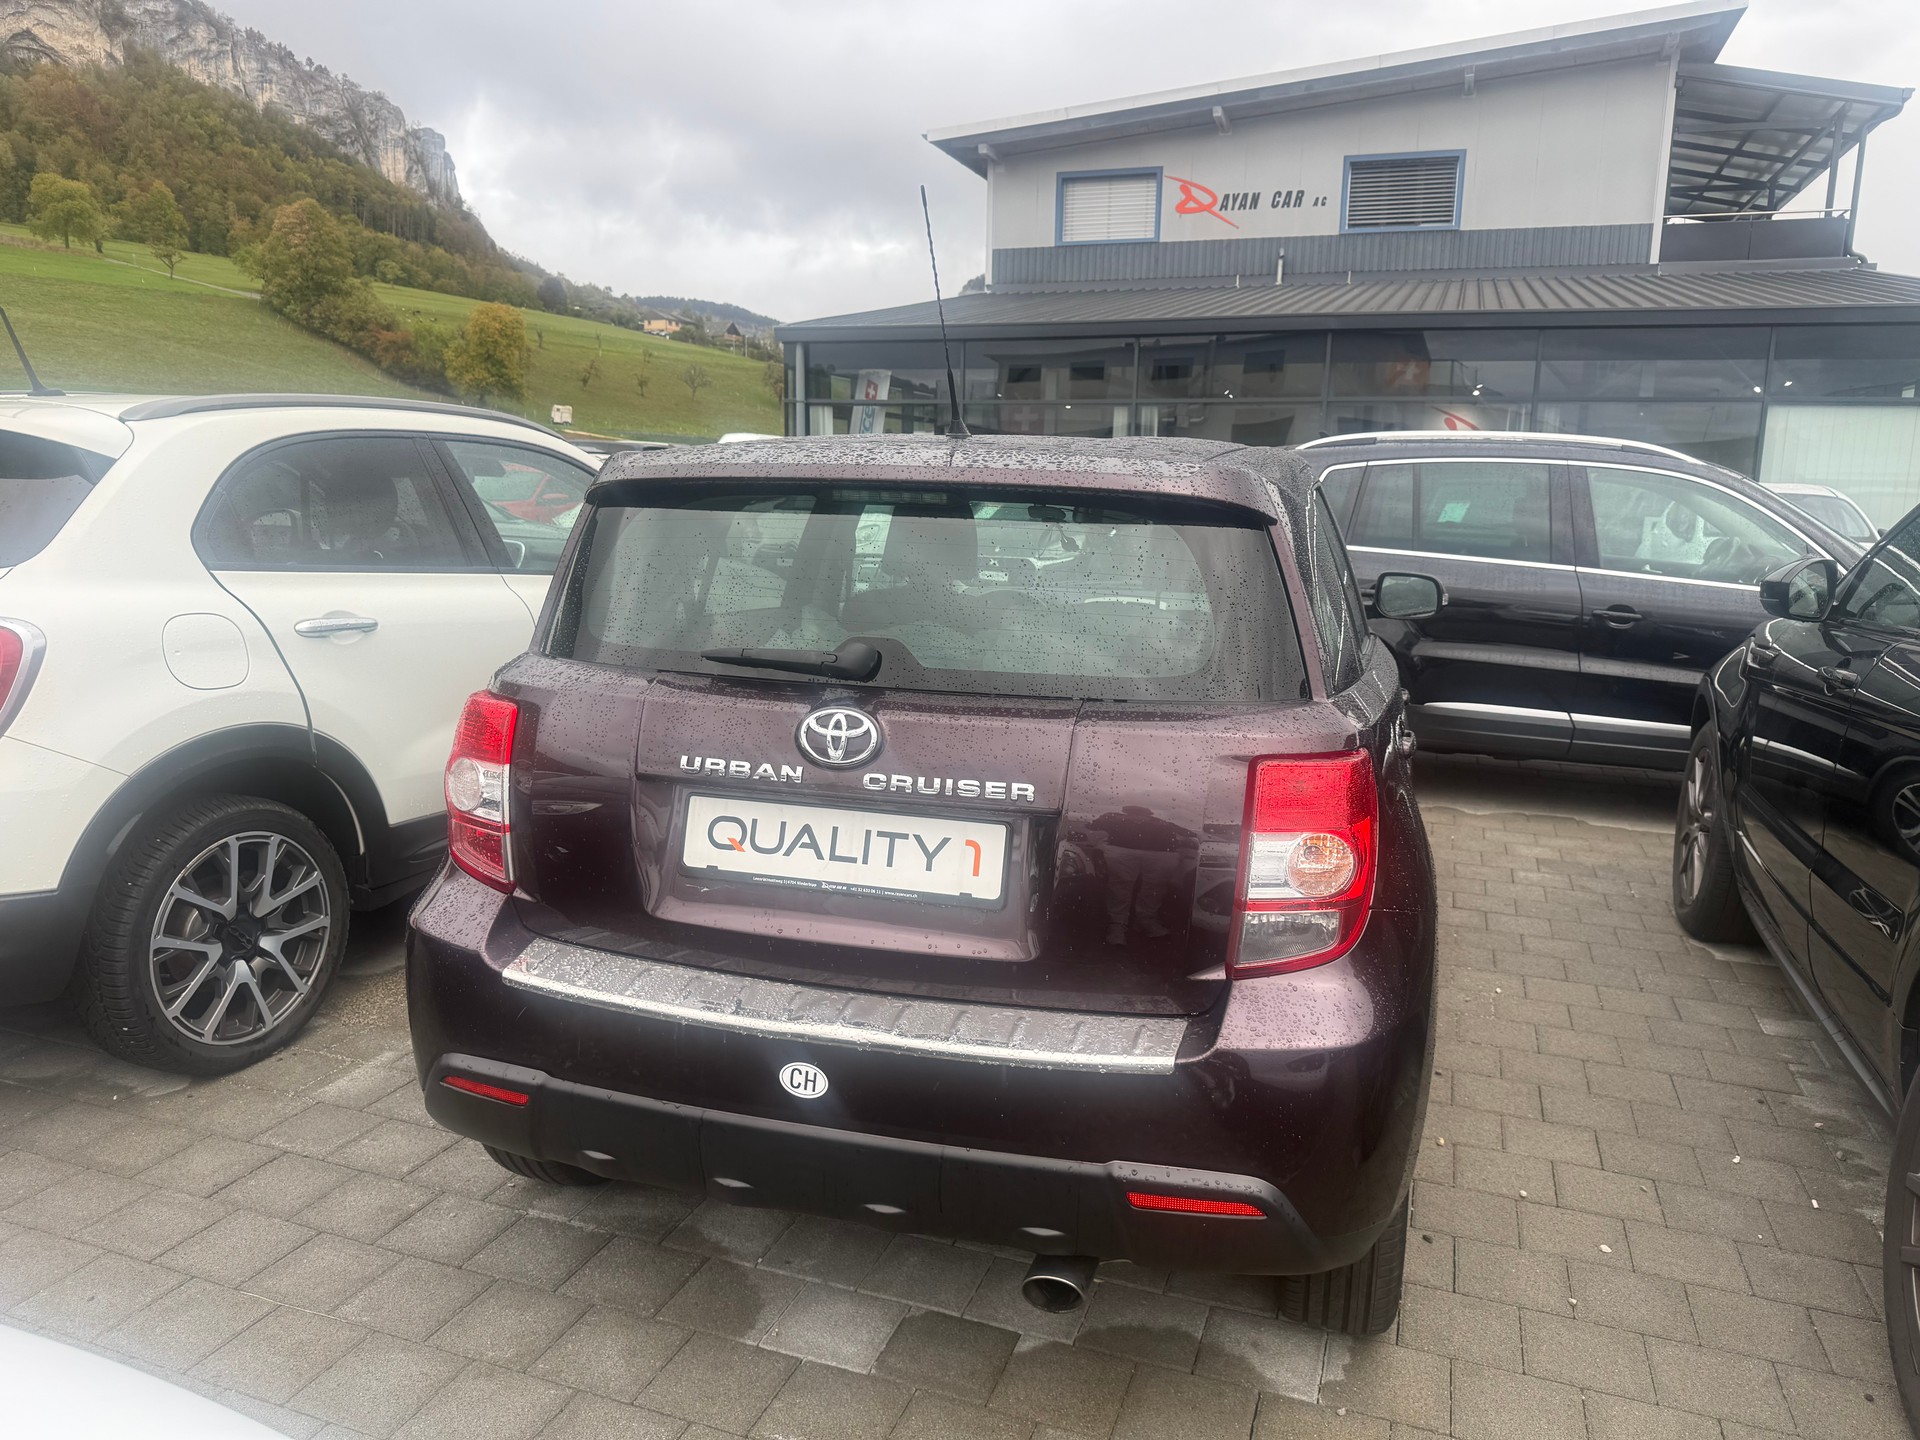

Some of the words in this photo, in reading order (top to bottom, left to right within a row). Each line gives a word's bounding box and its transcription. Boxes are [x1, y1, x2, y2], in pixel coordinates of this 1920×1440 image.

[1270, 190, 1305, 209] CAR
[679, 755, 804, 783] URBAN
[862, 772, 1036, 802] CRUISER
[790, 1068, 817, 1092] CH
